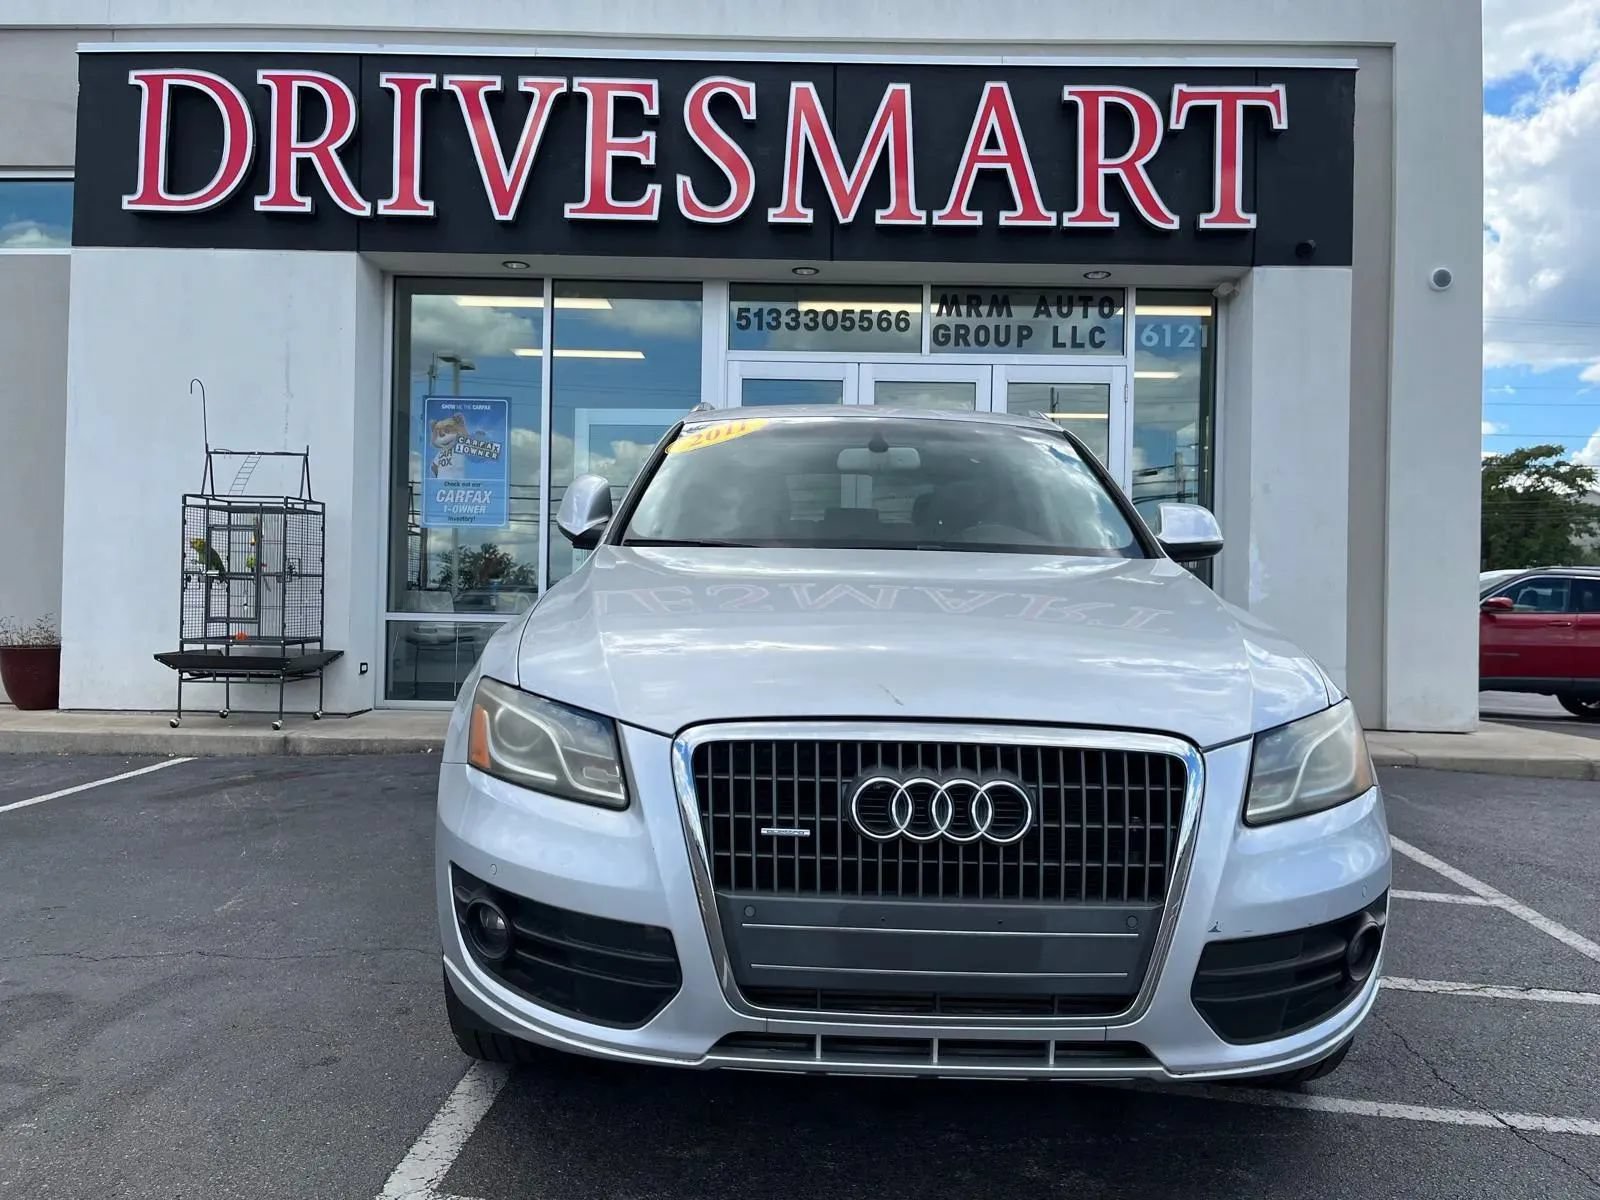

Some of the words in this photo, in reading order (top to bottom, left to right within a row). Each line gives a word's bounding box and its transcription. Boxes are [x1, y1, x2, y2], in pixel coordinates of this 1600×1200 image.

[121, 67, 1288, 231] DRIVESMART
[935, 293, 1013, 318] MRM
[1033, 295, 1114, 318] AUTO
[736, 307, 911, 333] 5133305566
[932, 323, 1033, 347] GROUP
[1052, 325, 1106, 349] LLC
[1140, 324, 1209, 348] 6121
[458, 437, 500, 453] CARFAX
[463, 446, 498, 460] OWNER
[436, 489, 492, 504] CARFAX
[443, 504, 487, 514] 1-OWNER
